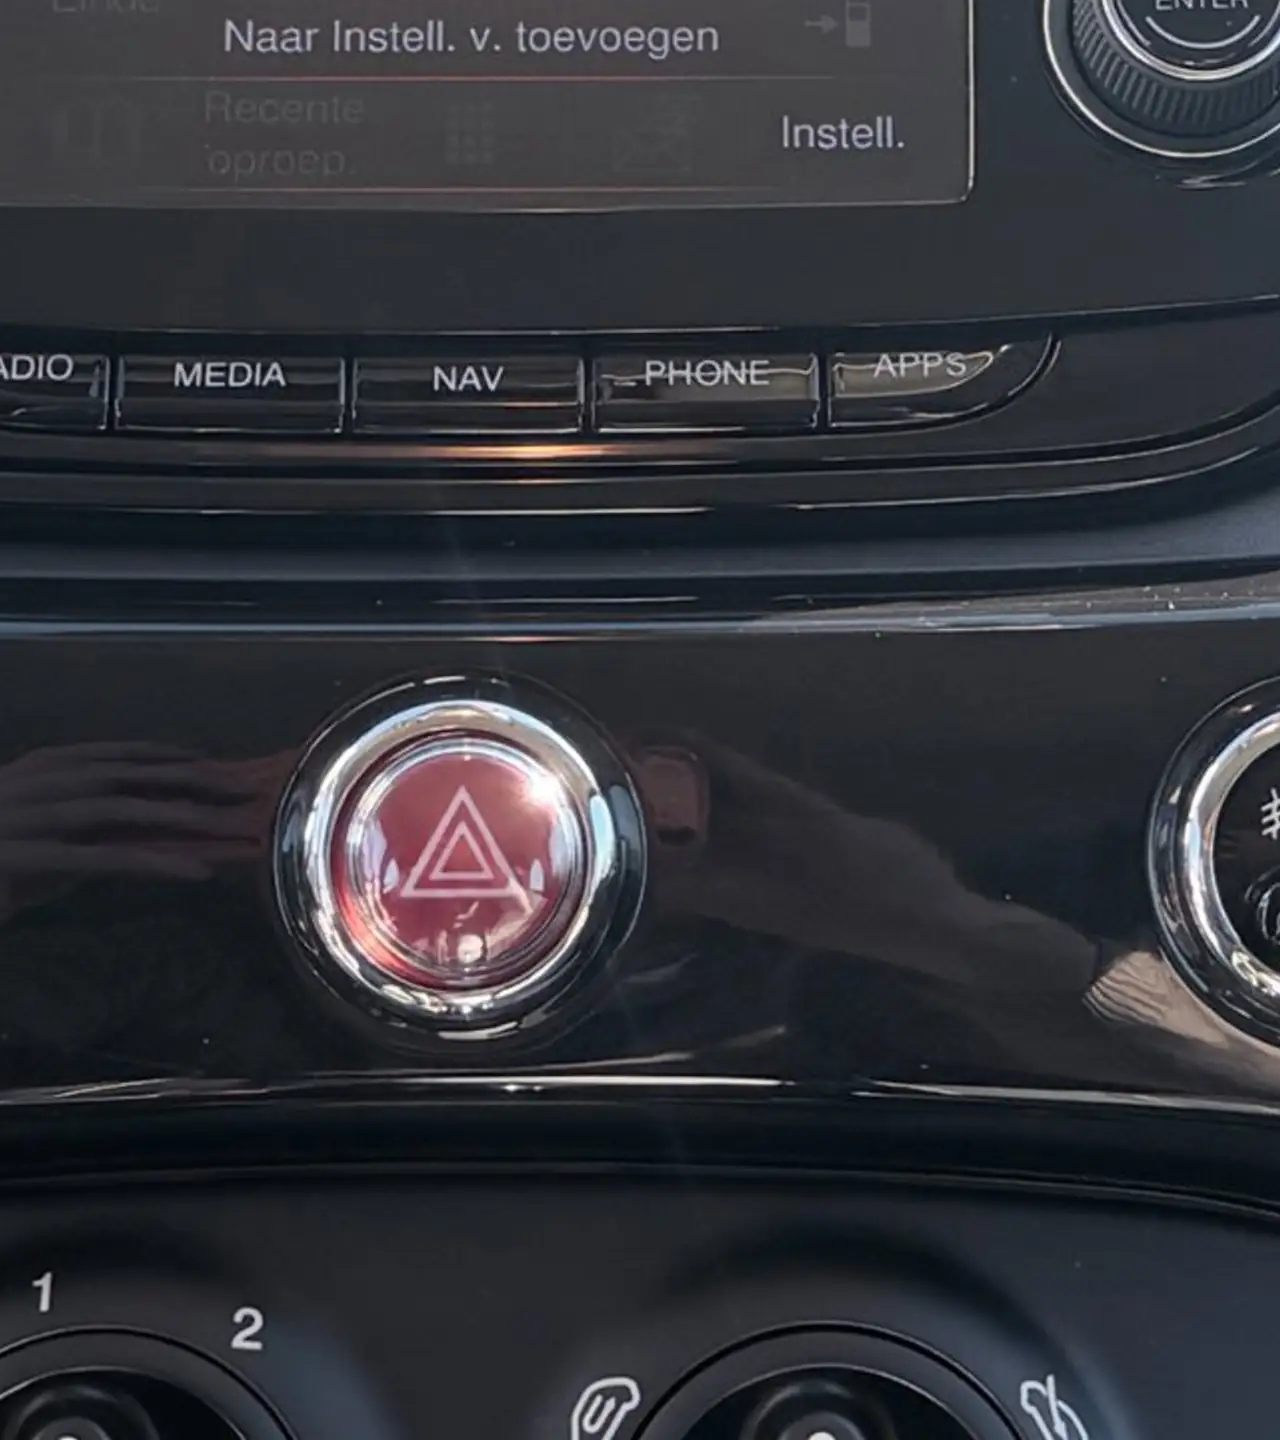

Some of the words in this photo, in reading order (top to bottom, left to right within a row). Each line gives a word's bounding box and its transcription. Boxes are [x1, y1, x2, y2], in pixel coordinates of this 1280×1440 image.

[224, 20, 318, 53] Naar
[333, 20, 455, 53] Instell.
[470, 26, 500, 53] v.
[517, 21, 720, 59] toevoegen
[204, 90, 366, 124] Recente
[782, 115, 906, 150] Instell.
[173, 362, 287, 388] MEDIA
[432, 365, 504, 392] NAV
[645, 359, 771, 387] PHONE
[873, 353, 968, 379] APPS
[32, 1271, 54, 1313] 1
[230, 1306, 265, 1351] 2
